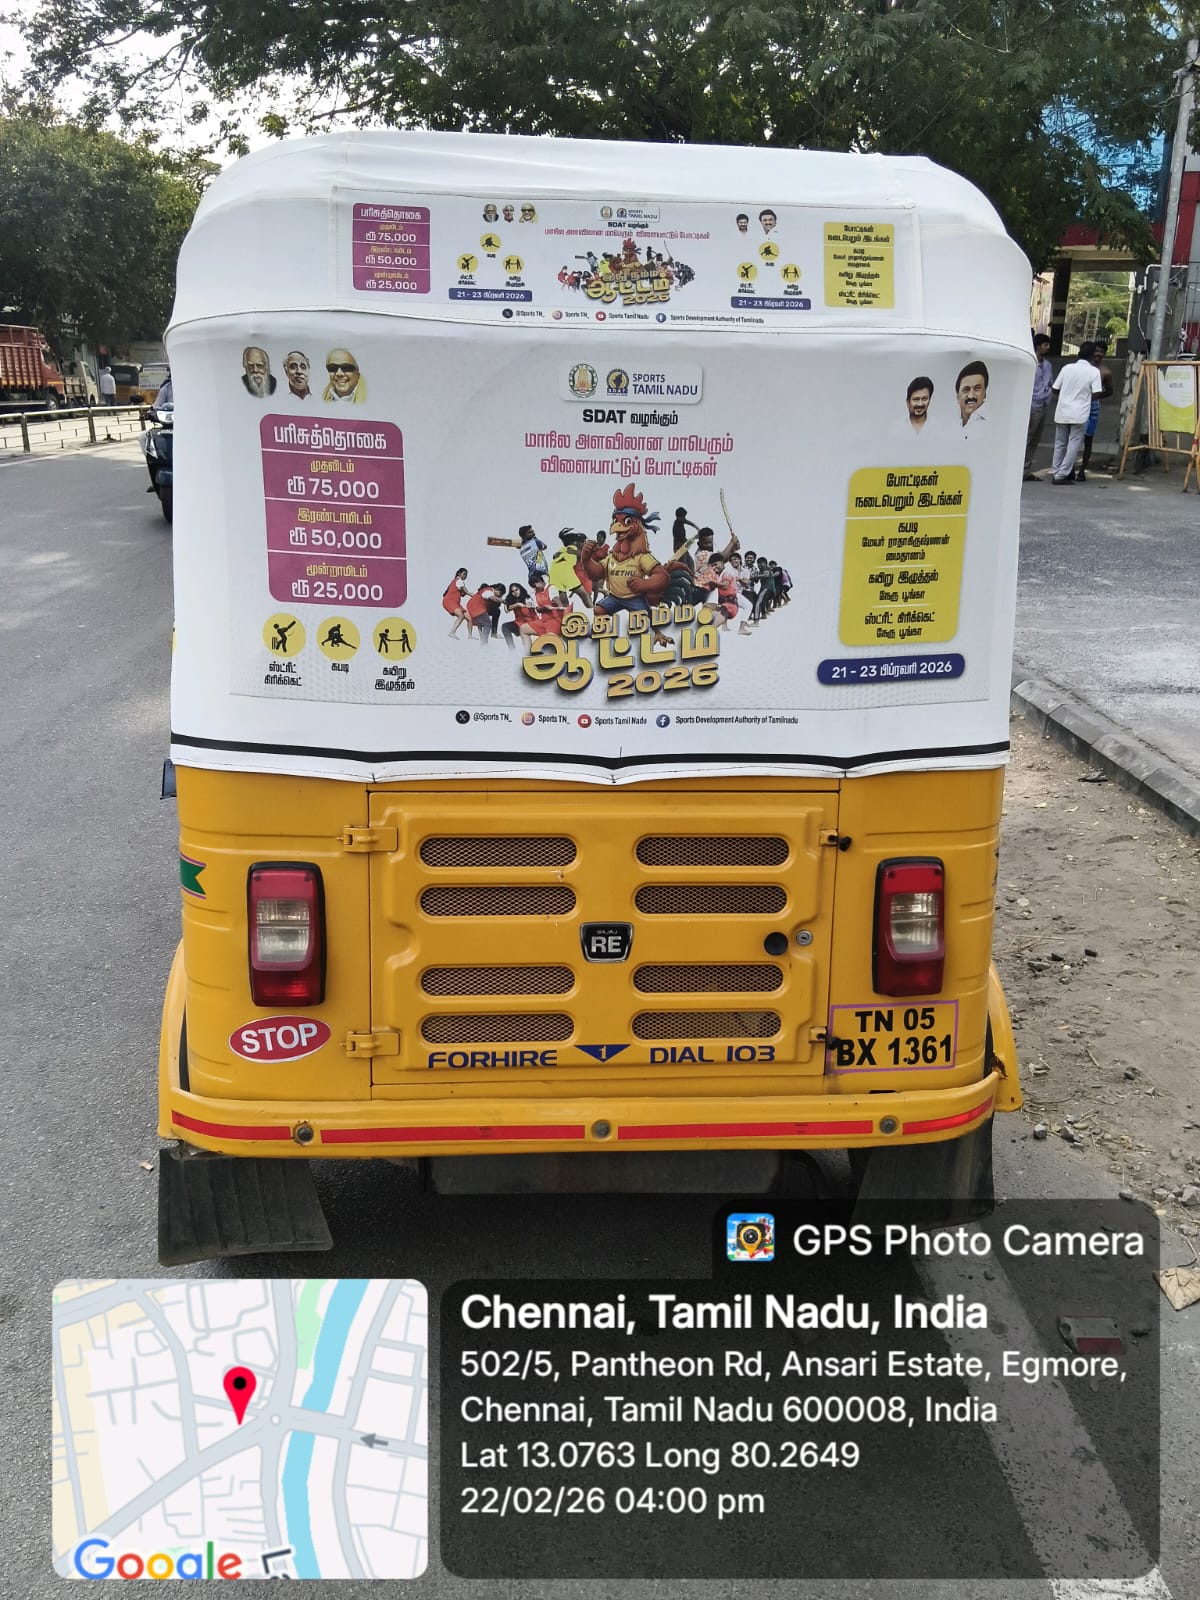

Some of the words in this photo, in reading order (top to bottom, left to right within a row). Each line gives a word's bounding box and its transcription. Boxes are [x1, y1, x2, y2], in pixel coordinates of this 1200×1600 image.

[378, 232, 417, 242] 75,000
[377, 256, 417, 266] 50,000
[379, 280, 417, 290] 25,000
[623, 293, 671, 305] 2026
[632, 373, 666, 383] SPORTS
[632, 384, 665, 395] TAMIL
[666, 385, 698, 396] NADU
[582, 409, 627, 424] SDAT
[630, 410, 679, 427] வழங்கும்
[273, 423, 387, 451] பரிசுத்தொகை
[525, 430, 571, 449] மாநில
[575, 432, 664, 452] அளவிலான
[668, 432, 734, 455] மாபெரும்
[310, 459, 355, 473] முதலிடம்
[540, 455, 641, 478] விளையாட்டுப்
[645, 456, 718, 479] போட்டிகள்
[287, 476, 306, 495] ரூ
[308, 477, 380, 499] 75,000
[886, 471, 939, 489] போட்டிகள்
[855, 491, 914, 511] நடைபெறும்
[917, 490, 963, 508] இடங்கள்
[297, 508, 373, 525] இரண்டாமிடம்
[898, 522, 919, 534] கபடி
[289, 527, 307, 546] ரூ
[311, 529, 383, 549] 50,000
[306, 562, 368, 578] மூன்றாமிடம்
[868, 572, 894, 587] கயிறு
[292, 579, 310, 598] ரூ
[313, 581, 383, 601] 25,000
[560, 610, 618, 639] இது
[627, 603, 695, 636] நம்ம
[522, 607, 720, 692] ஆட்டம்
[331, 662, 350, 675] கபடி
[382, 666, 407, 680] கயிறு
[831, 665, 847, 679] 21
[860, 665, 878, 678] 23
[879, 662, 917, 678] பிப்ரவரி
[919, 660, 953, 675] 2026
[607, 663, 719, 698] 2026
[473, 712, 499, 721] @Sports
[538, 714, 558, 724] Sports
[594, 716, 614, 726] Sports
[614, 716, 631, 725] Tamil
[675, 715, 695, 724] Sports
[695, 715, 734, 725] Development
[735, 715, 761, 725] Authority
[761, 715, 768, 724] of
[768, 716, 799, 724] Tamilnadu
[591, 936, 622, 953] RE
[855, 1010, 894, 1033] TN
[903, 1007, 936, 1031] 05
[241, 1022, 318, 1054] STOP
[427, 1049, 558, 1069] FORHIRE
[650, 1046, 714, 1065] DIAL
[727, 1045, 776, 1064] 103
[837, 1038, 877, 1066] BX
[887, 1034, 952, 1065] 1361
